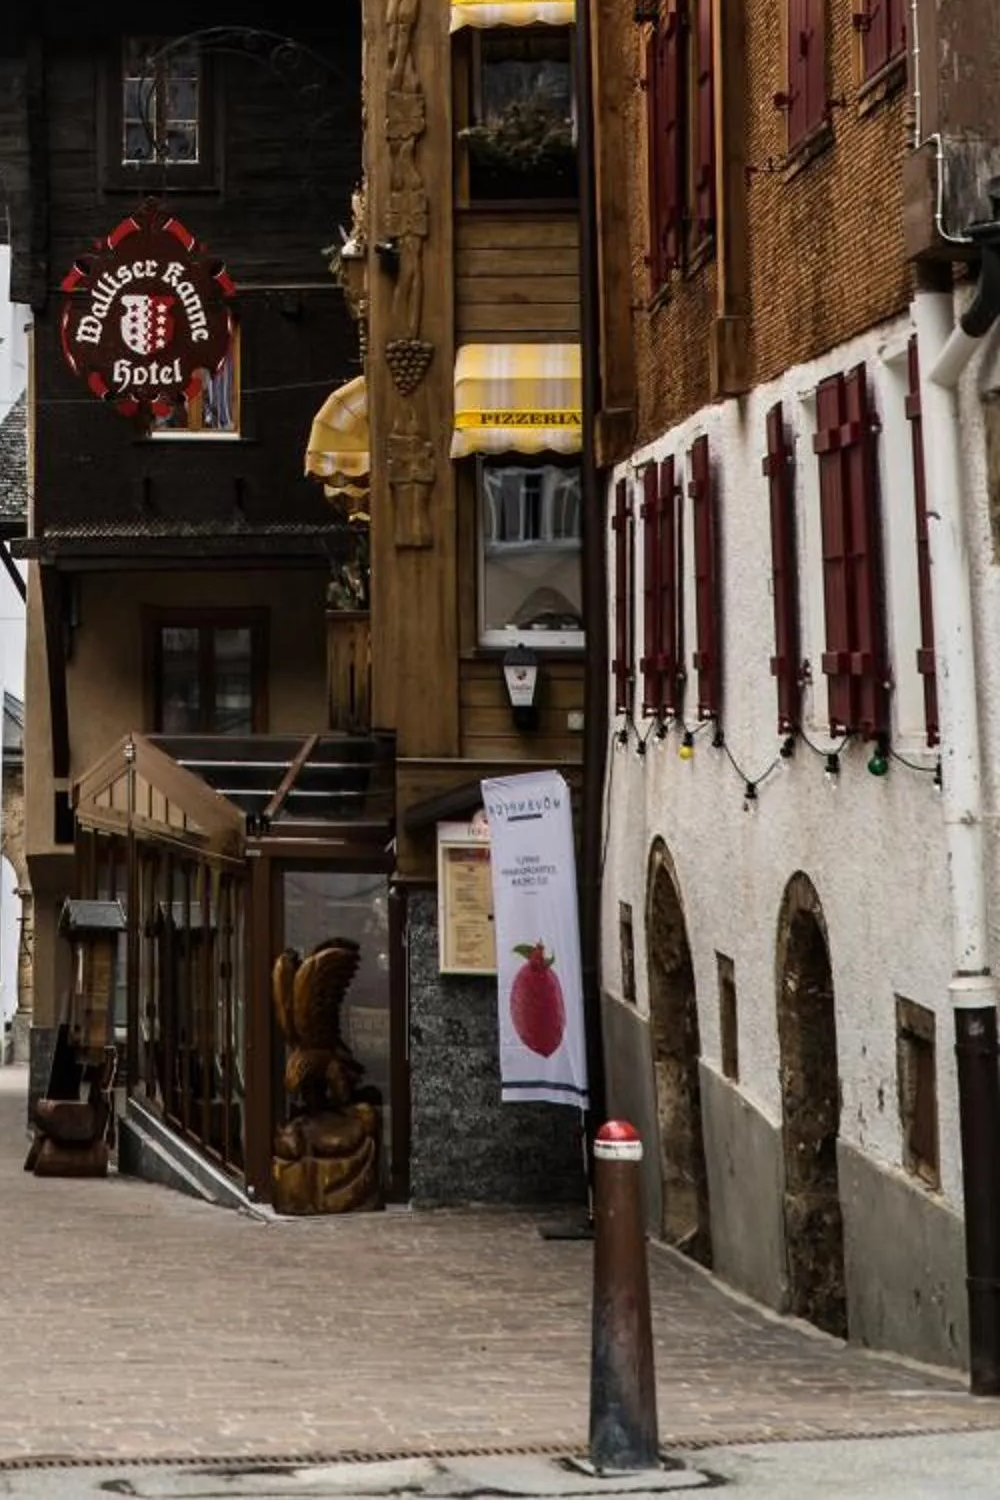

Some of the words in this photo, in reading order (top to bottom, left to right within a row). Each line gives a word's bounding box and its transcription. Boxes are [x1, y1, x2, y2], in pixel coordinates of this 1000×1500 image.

[75, 259, 159, 345] Walliser
[161, 261, 209, 343] Kanne
[112, 357, 183, 393] Hotel
[480, 411, 581, 425] PIZZERIA
